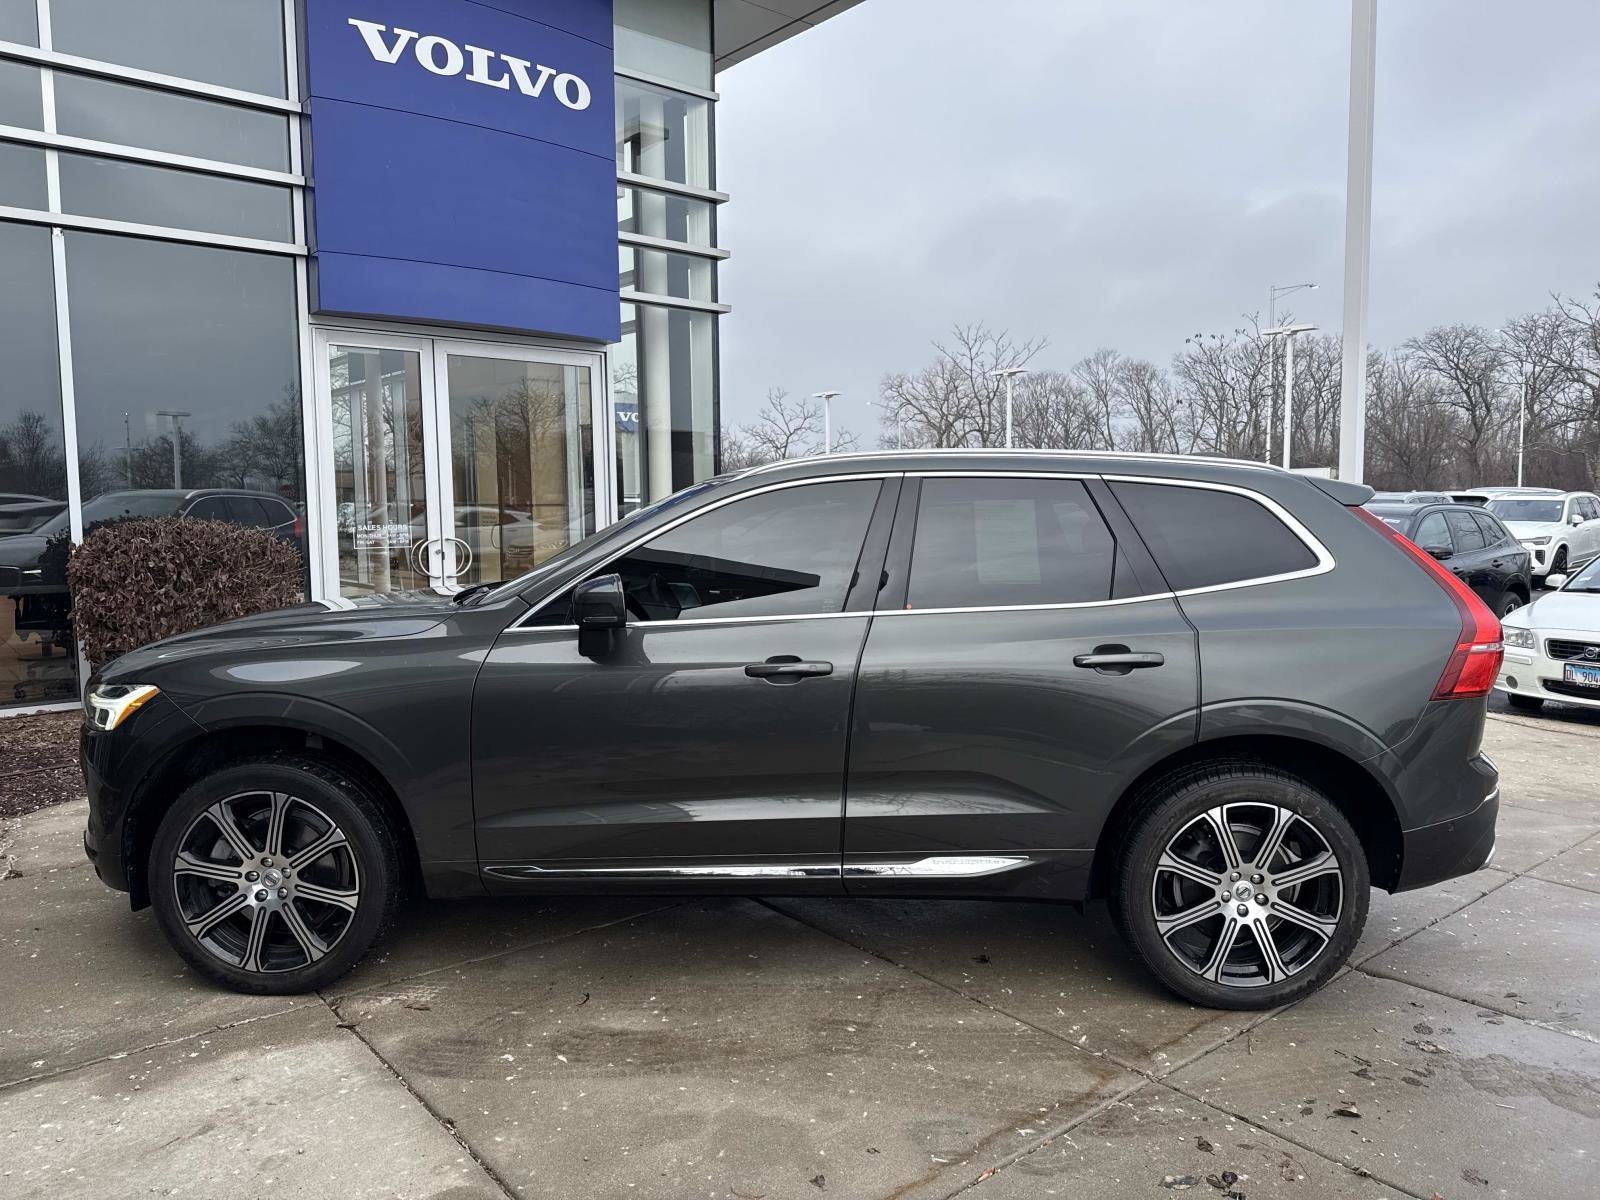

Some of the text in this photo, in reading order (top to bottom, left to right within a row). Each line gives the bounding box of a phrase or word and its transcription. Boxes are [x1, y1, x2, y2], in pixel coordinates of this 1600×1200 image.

[348, 18, 591, 111] VOLVO
[616, 411, 639, 422] VO
[1583, 672, 1600, 683] 904
